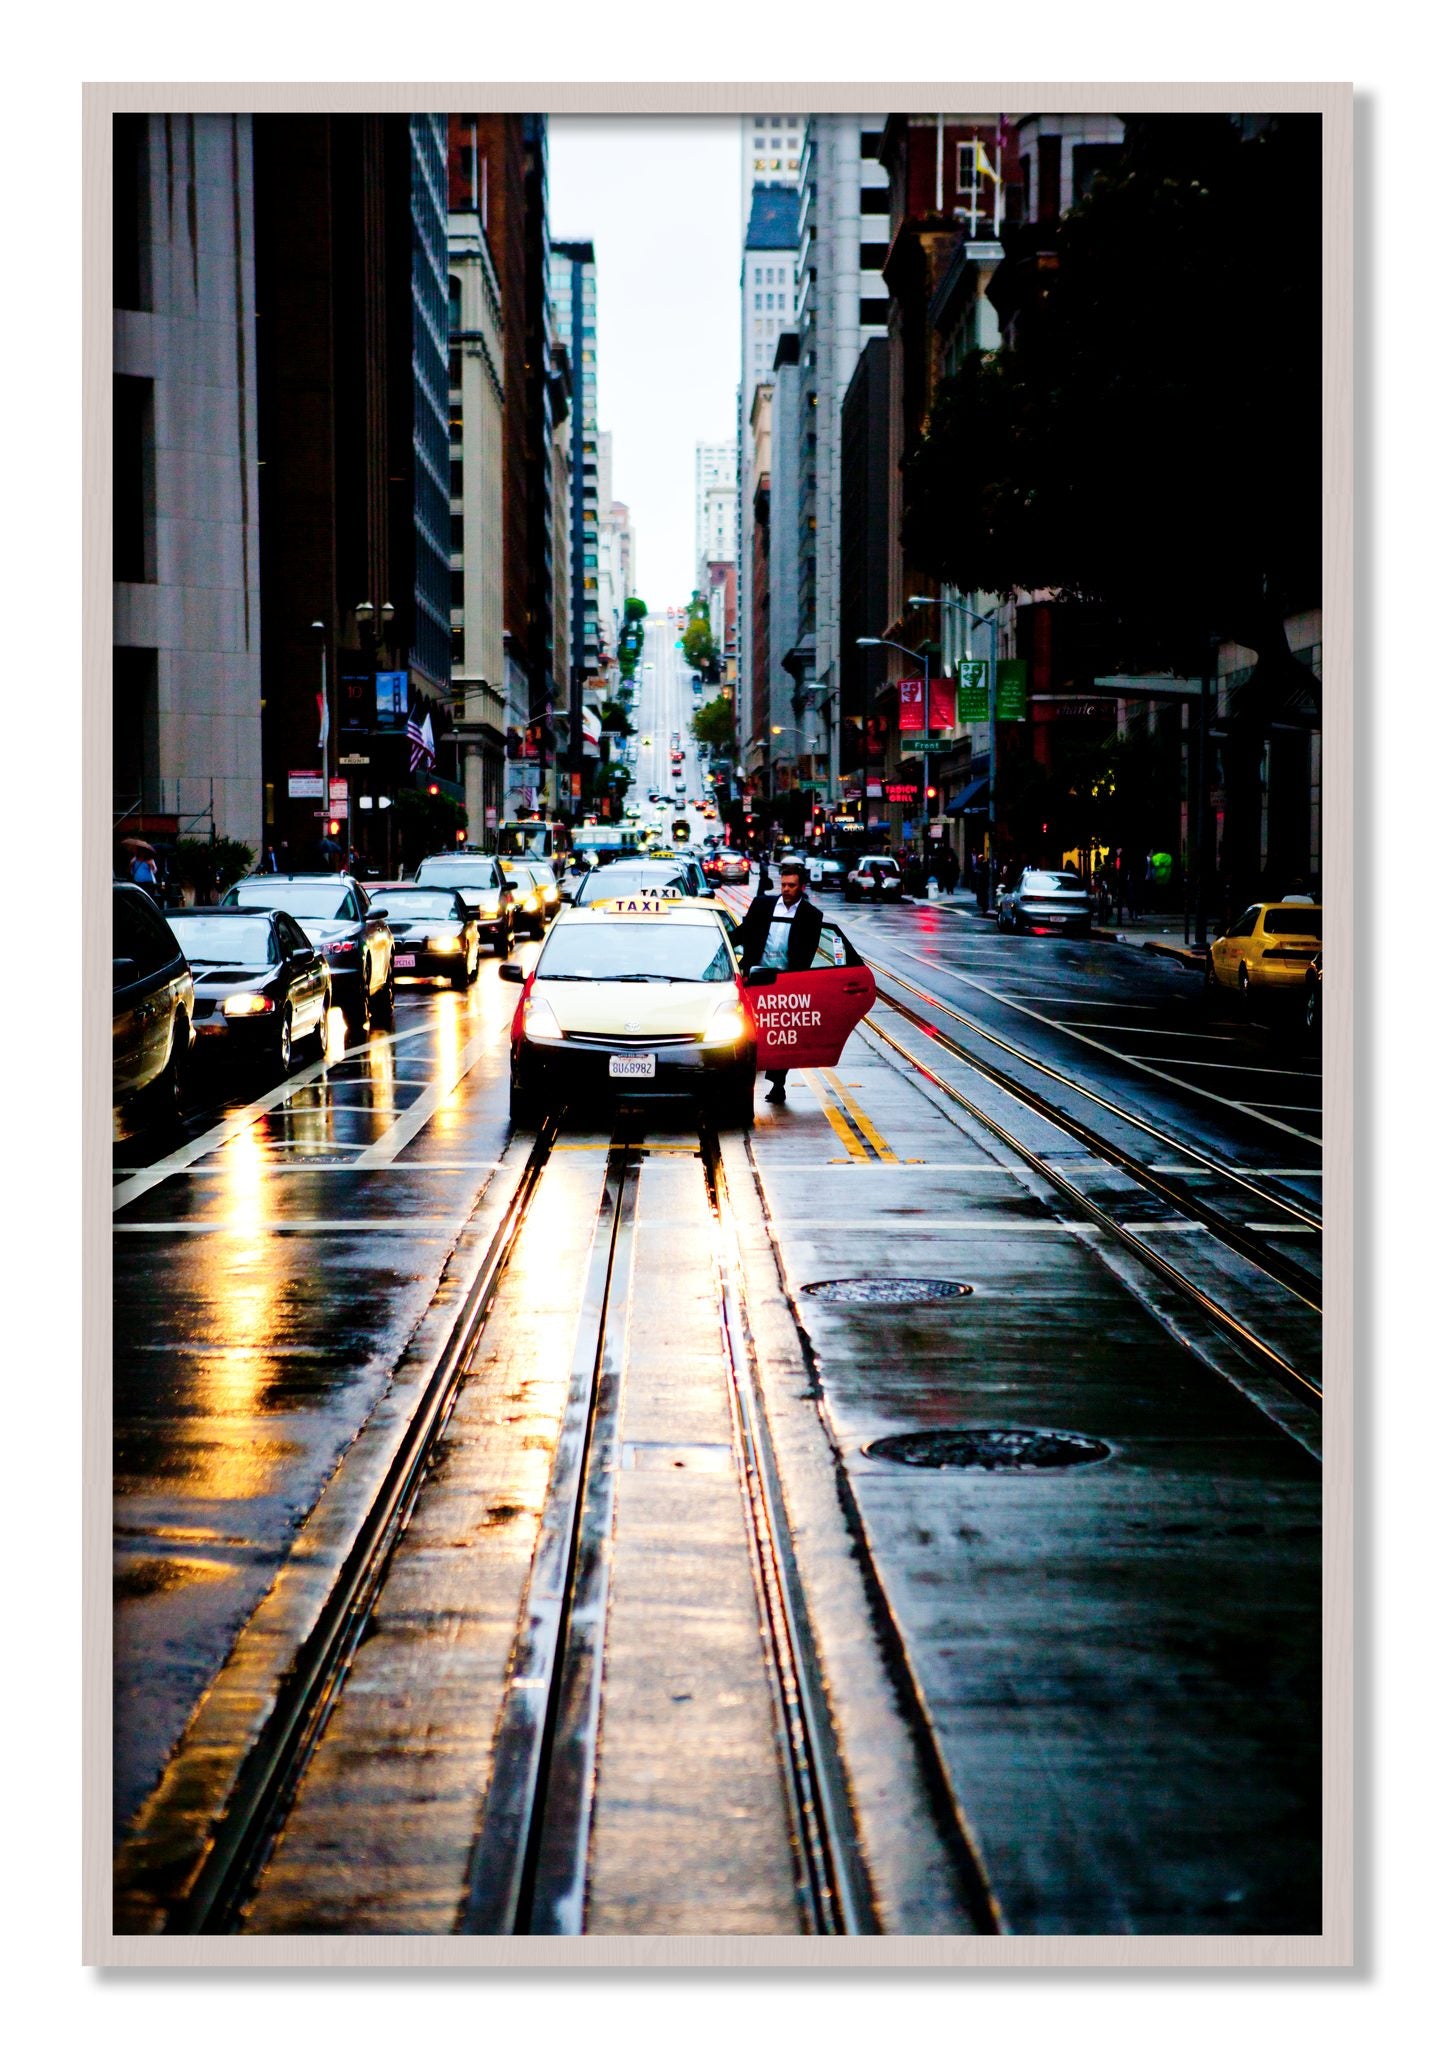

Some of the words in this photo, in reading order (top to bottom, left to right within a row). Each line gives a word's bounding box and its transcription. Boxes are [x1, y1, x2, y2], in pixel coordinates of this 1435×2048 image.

[915, 742, 939, 750] Front
[889, 794, 913, 803] GRILL
[641, 889, 676, 898] TAXI
[616, 901, 660, 912] TAXI
[757, 993, 811, 1010] ARROW
[766, 1030, 797, 1046] CAB
